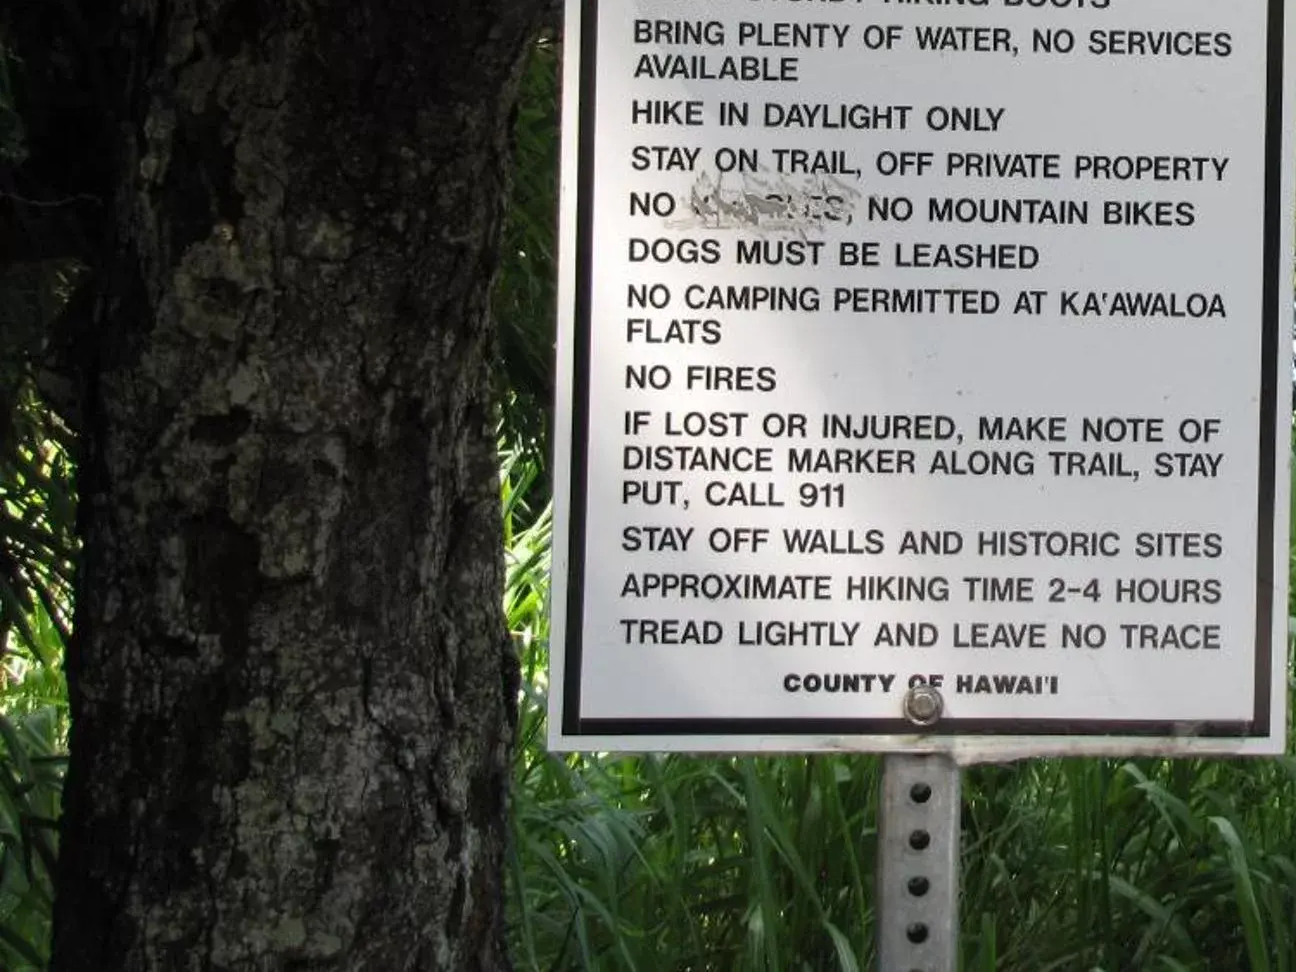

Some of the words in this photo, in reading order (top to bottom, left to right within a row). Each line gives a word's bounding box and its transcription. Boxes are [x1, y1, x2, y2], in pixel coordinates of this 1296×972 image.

[634, 20, 724, 46] BRING
[739, 22, 850, 48] PLENTY
[864, 25, 903, 49] OF
[916, 26, 1018, 57] WATER,
[1033, 29, 1074, 53] NO
[1088, 30, 1232, 57] SERVICES
[634, 54, 798, 81] AVAILABLE
[632, 100, 703, 125] HIKE
[720, 102, 748, 126] IN
[764, 103, 912, 130] DAYLIGHT
[926, 106, 1005, 131] ONLY
[632, 146, 701, 171] STAY
[715, 148, 757, 174] ON
[772, 149, 861, 180] TRAIL,
[876, 151, 934, 176] OFF
[947, 153, 1060, 179] PRIVATE
[1075, 155, 1229, 181] PROPERTY
[630, 192, 676, 217] NO
[869, 196, 913, 222] NO
[929, 198, 1088, 224] MOUNTAIN
[1104, 201, 1194, 226] BIKES
[629, 238, 721, 264] DOGS
[737, 241, 825, 265] MUST
[840, 242, 880, 266] BE
[895, 243, 1039, 269] LEASHED
[628, 284, 670, 309] NO
[685, 284, 819, 311] CAMPING
[834, 288, 1000, 314] PERMITTED
[1013, 291, 1047, 315] AT
[627, 319, 721, 344] FLATS
[626, 365, 671, 390] NO
[687, 366, 776, 392] FIRES
[625, 411, 651, 435] IF
[665, 412, 748, 437] LOST
[763, 413, 807, 438] OR
[823, 414, 963, 444] INJURED,
[979, 417, 1066, 442] MAKE
[1083, 417, 1164, 442] NOTE
[1179, 419, 1221, 443] OF
[624, 446, 773, 472] DISTANCE
[788, 448, 915, 474] MARKER
[929, 450, 1034, 475] ALONG
[1048, 452, 1139, 482] TRAIL,
[1155, 452, 1223, 477] STAY
[623, 481, 689, 510] PUT,
[705, 481, 784, 506] CALL
[800, 483, 844, 507] 911
[622, 526, 694, 551] STAY
[709, 528, 769, 552] OFF
[783, 529, 884, 554] WALLS
[899, 531, 963, 555] AND
[978, 531, 1120, 556] HISTORIC
[1136, 533, 1222, 558] SITES
[621, 573, 831, 600] APPROXIMATE
[847, 576, 949, 601] HIKING
[963, 577, 1033, 602] TIME
[1049, 578, 1101, 602] 2-4
[1116, 579, 1221, 604] HOURS
[620, 619, 723, 644] TREAD
[739, 621, 860, 646] LIGHTLY
[874, 623, 938, 647] AND
[954, 623, 1046, 648] LEAVE
[1062, 624, 1106, 649] NO
[1120, 625, 1220, 649] TRACE
[784, 674, 895, 692] COUNTY
[957, 675, 1058, 694] HAWAI'I
